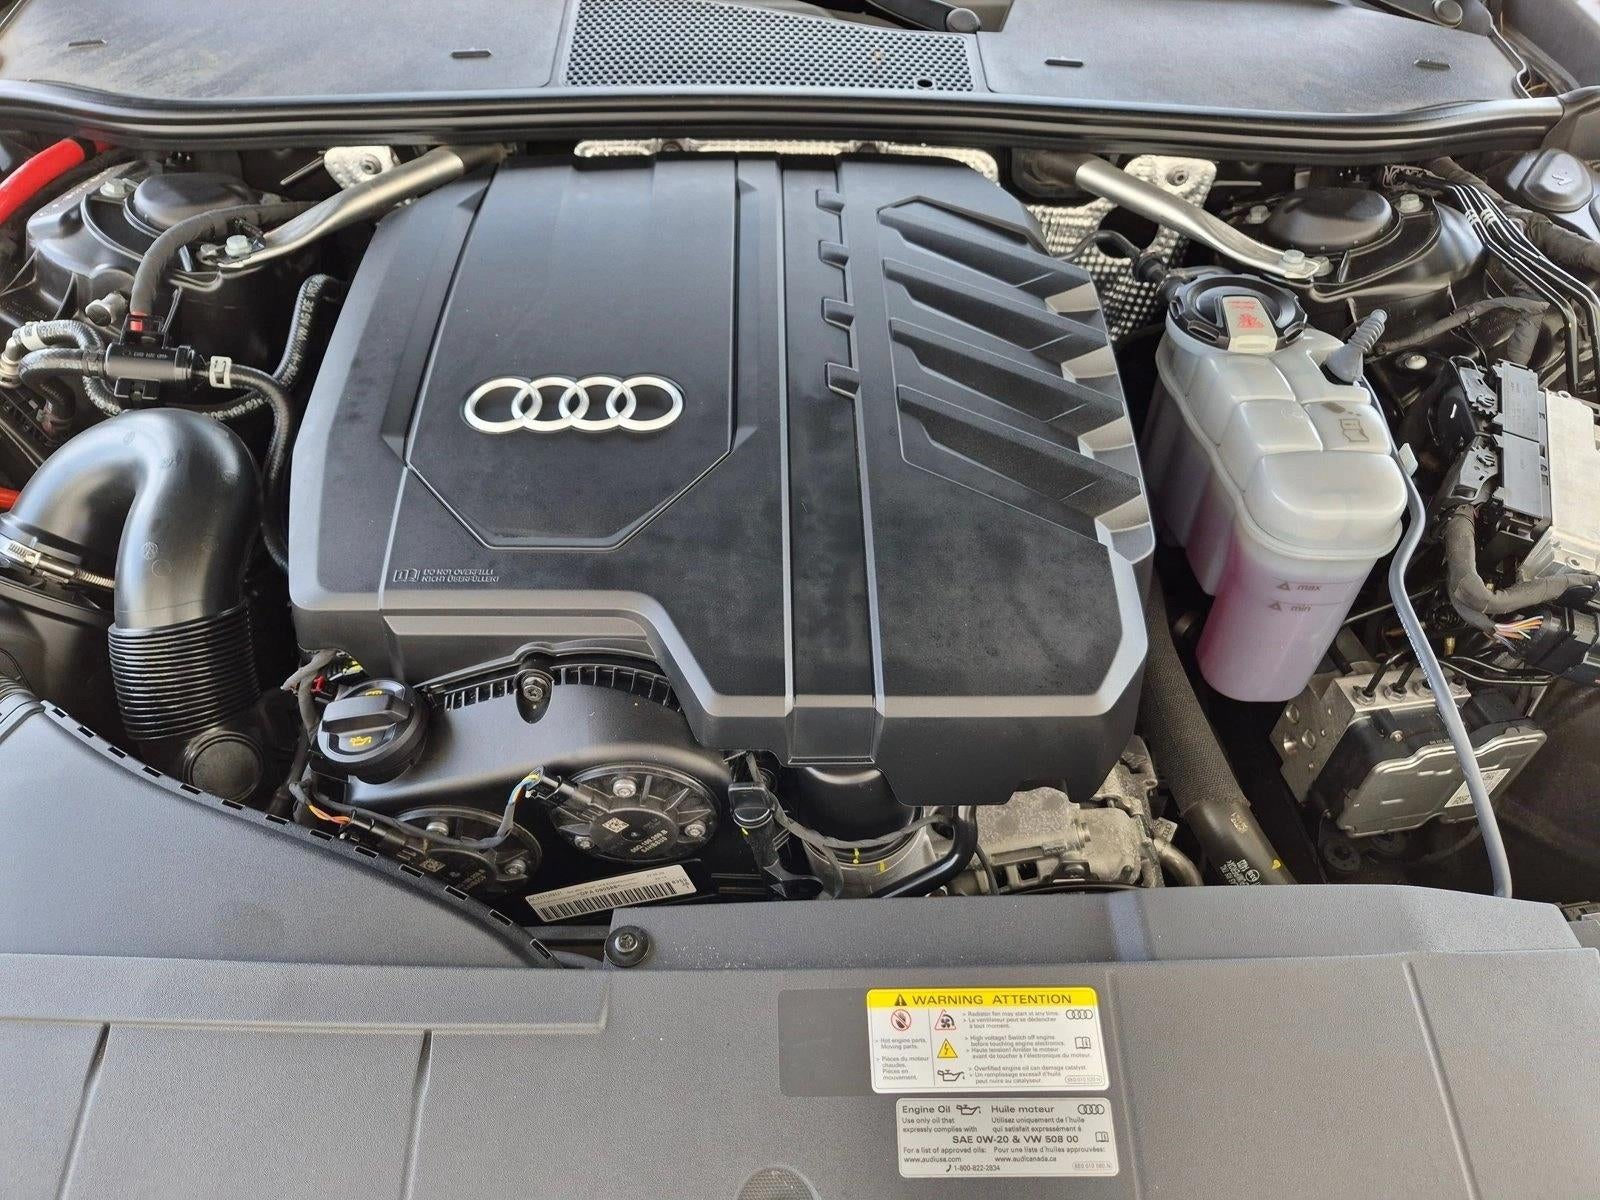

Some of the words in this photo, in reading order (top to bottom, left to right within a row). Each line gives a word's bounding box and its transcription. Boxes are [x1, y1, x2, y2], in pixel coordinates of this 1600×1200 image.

[1297, 584, 1321, 592] max
[1290, 603, 1312, 612] min
[912, 995, 984, 1005] WARNING
[992, 994, 1072, 1005] ATTENTION
[902, 1105, 935, 1115] Engine
[937, 1105, 951, 1114] Oil
[991, 1104, 1016, 1113] Huile
[1018, 1105, 1055, 1114] moteur
[915, 1117, 931, 1125] only
[992, 1116, 1016, 1124] Utilisez
[1015, 1116, 1055, 1124] uniquement
[903, 1125, 932, 1134] expressly
[933, 1125, 963, 1134] complies
[992, 1125, 1003, 1133] qui
[952, 1135, 974, 1144] SAE
[976, 1135, 1009, 1143] 0W-20
[1011, 1135, 1020, 1143] &
[1023, 1135, 1042, 1143] VW
[1045, 1135, 1064, 1143] 508
[1066, 1135, 1079, 1143] 00
[941, 1146, 972, 1154] approved
